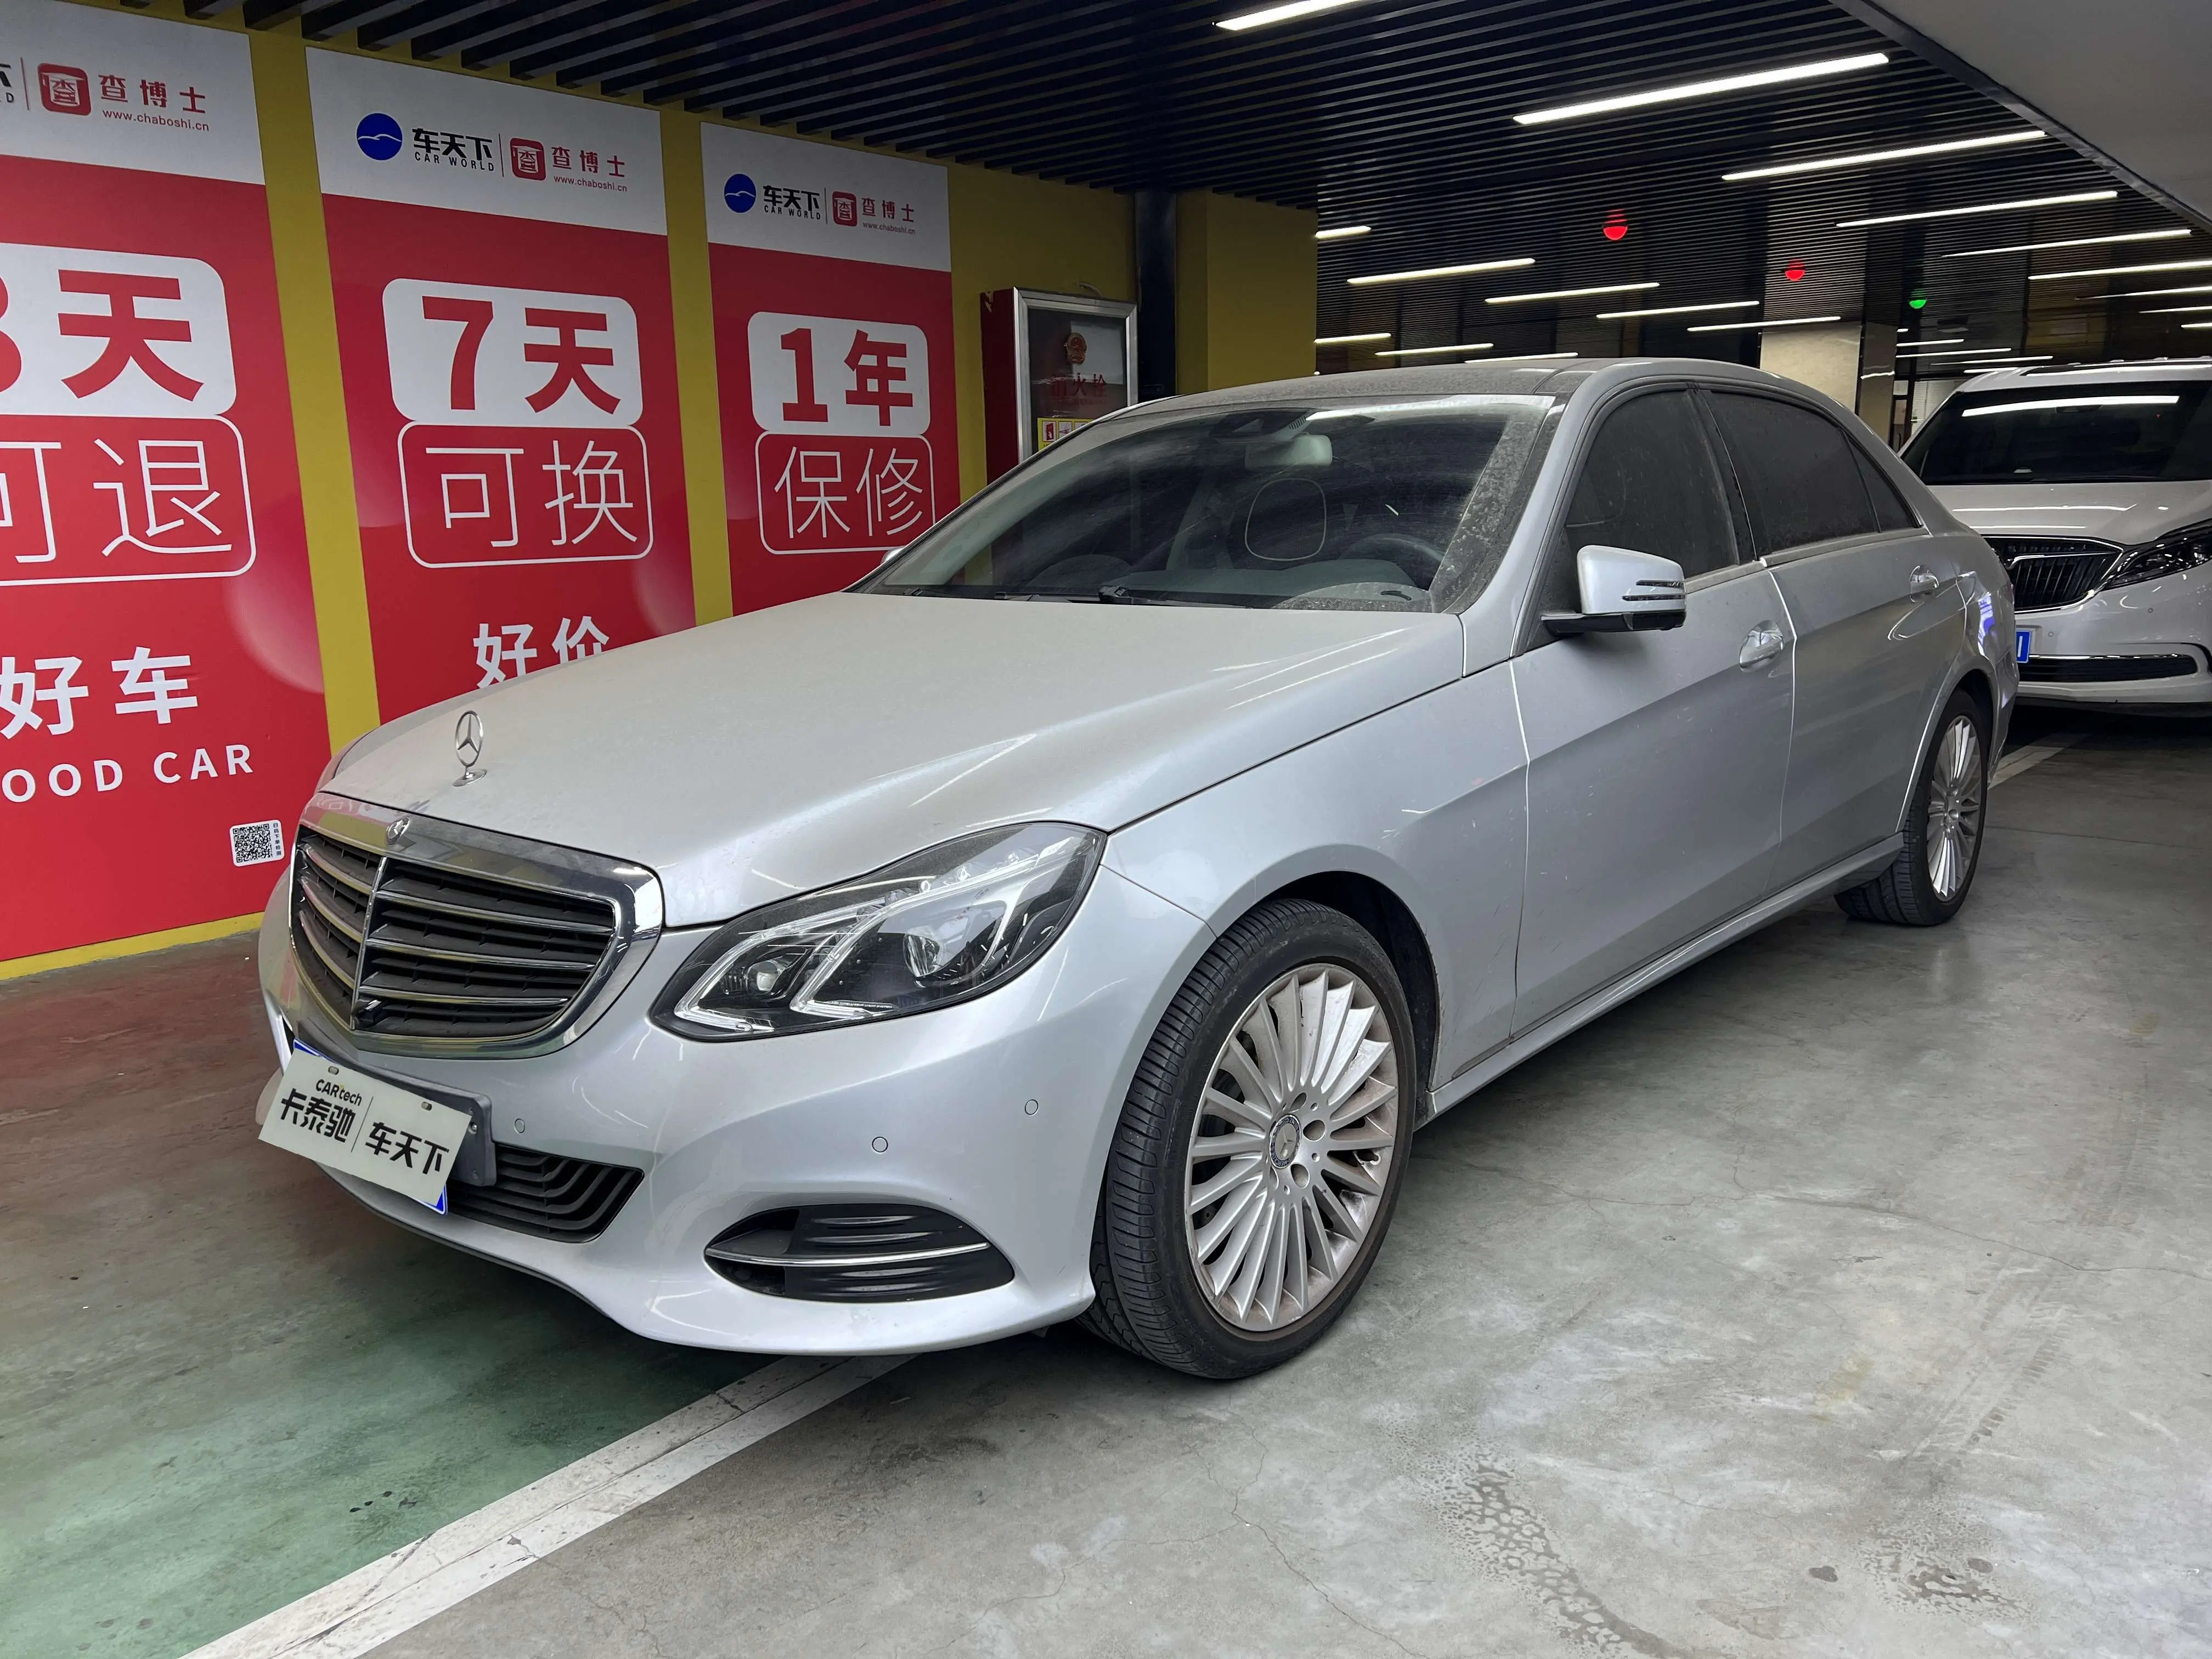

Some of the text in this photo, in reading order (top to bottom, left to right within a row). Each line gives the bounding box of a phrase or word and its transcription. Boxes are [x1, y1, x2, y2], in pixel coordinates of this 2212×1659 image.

[98, 75, 205, 114] 查博士
[102, 110, 209, 131] www.chaboshi.cn
[412, 128, 492, 161] 车天下
[551, 146, 625, 177] 查博士
[415, 151, 494, 171] CAR WORLD
[554, 176, 627, 192] www.chaboshi.cn
[763, 185, 820, 211] 车天下
[861, 198, 914, 222] 查博士
[764, 205, 821, 220] CAR WORLD
[862, 222, 916, 235] www.chaboshi.cn
[0, 269, 204, 402] 天
[421, 295, 620, 415] 7天
[780, 328, 913, 426] 1年
[426, 440, 637, 548] 可换
[774, 447, 923, 539] 保修
[0, 646, 198, 740] 好车
[153, 744, 253, 783] CAR
[315, 1079, 362, 1107] CARtech
[281, 1088, 449, 1175] 卡泰驰 车天下
